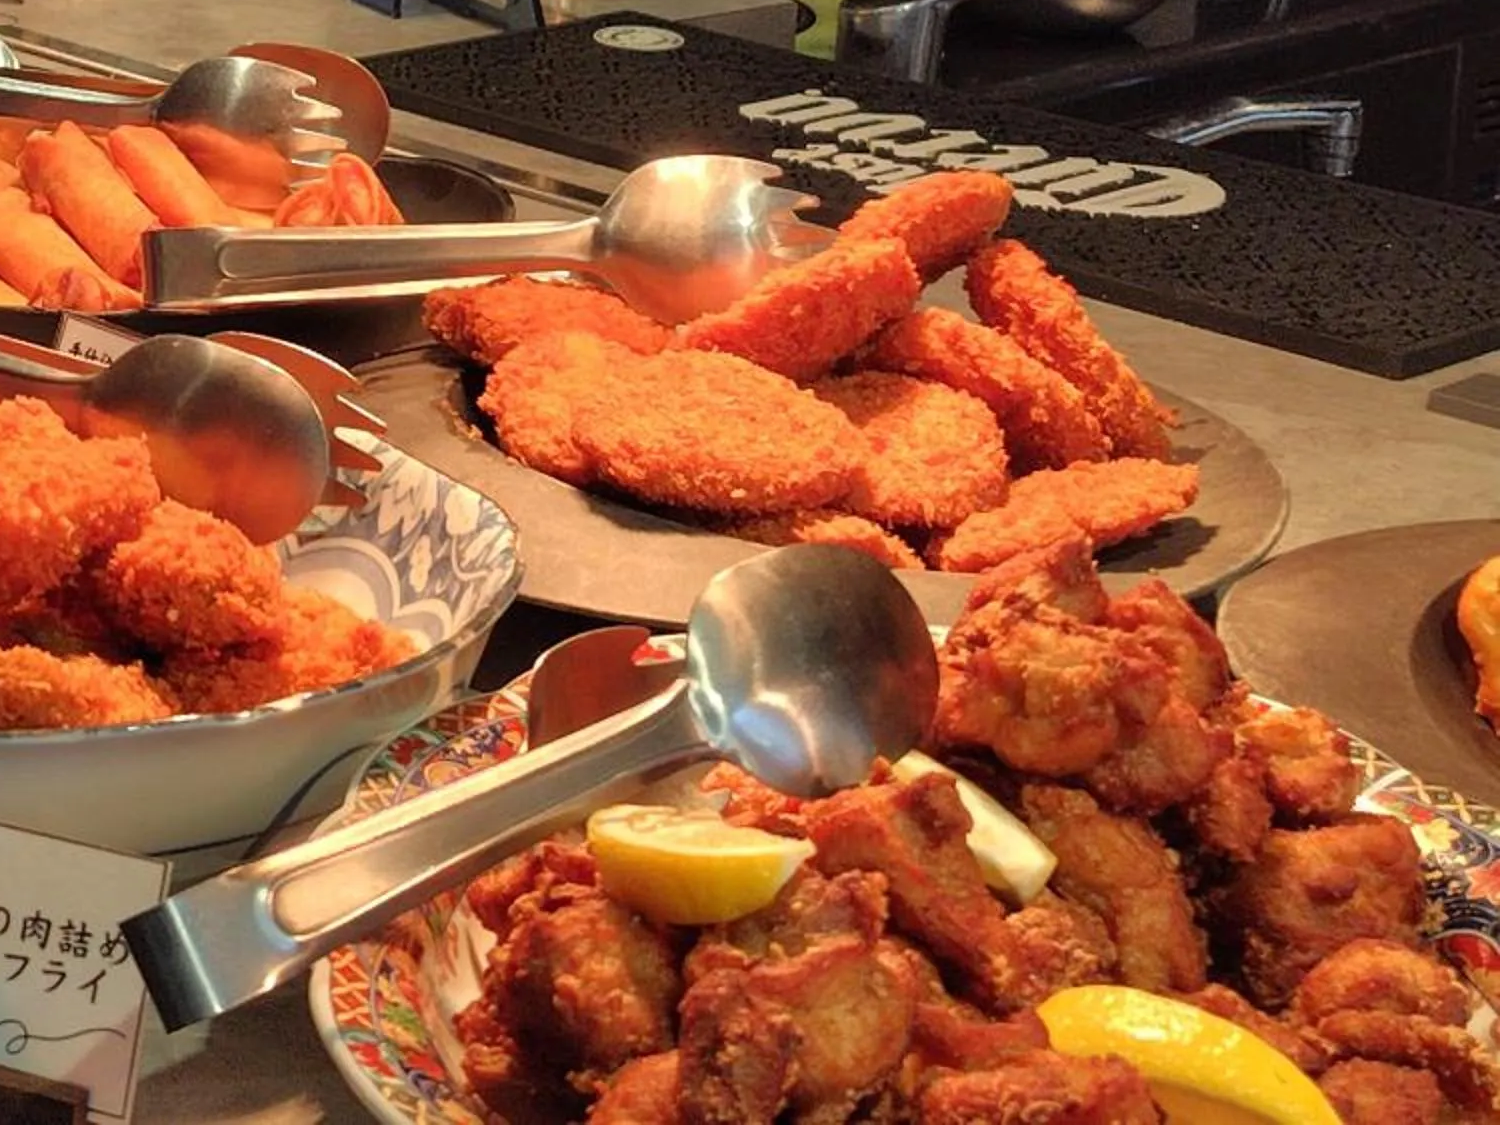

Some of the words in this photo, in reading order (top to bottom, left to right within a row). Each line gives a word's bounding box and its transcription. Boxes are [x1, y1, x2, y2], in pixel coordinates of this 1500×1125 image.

[738, 92, 1227, 218] Cuervo
[771, 143, 928, 195] ose
[2, 951, 111, 1005] フライ
